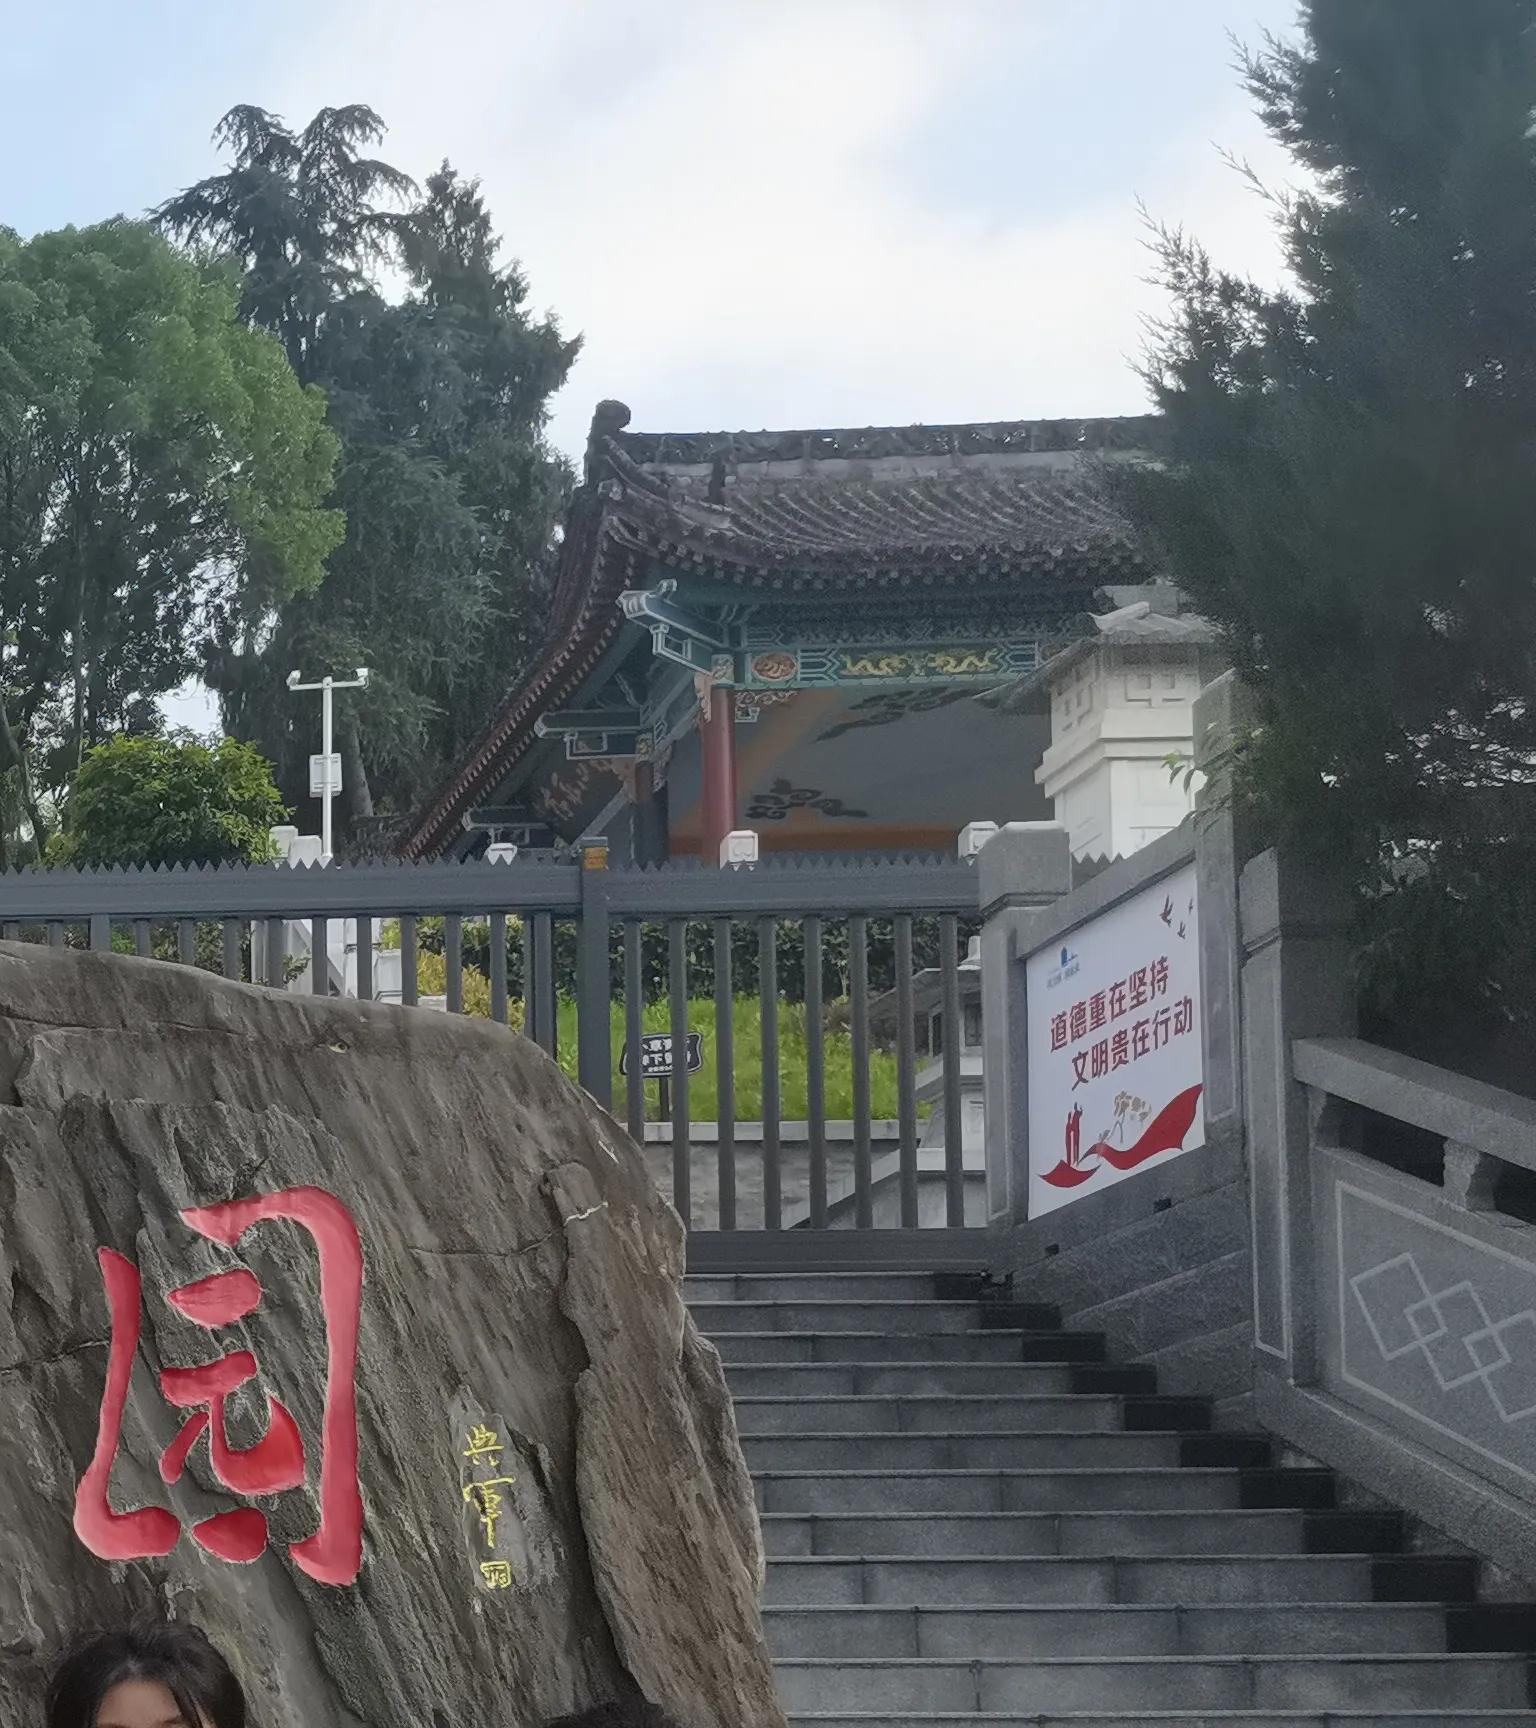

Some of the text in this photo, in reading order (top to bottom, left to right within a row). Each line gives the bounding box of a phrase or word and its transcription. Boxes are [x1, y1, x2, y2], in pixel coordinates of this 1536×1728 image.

[1050, 955, 1169, 1053] 道德重在坚持
[1071, 995, 1193, 1091] 文明贵在行动
